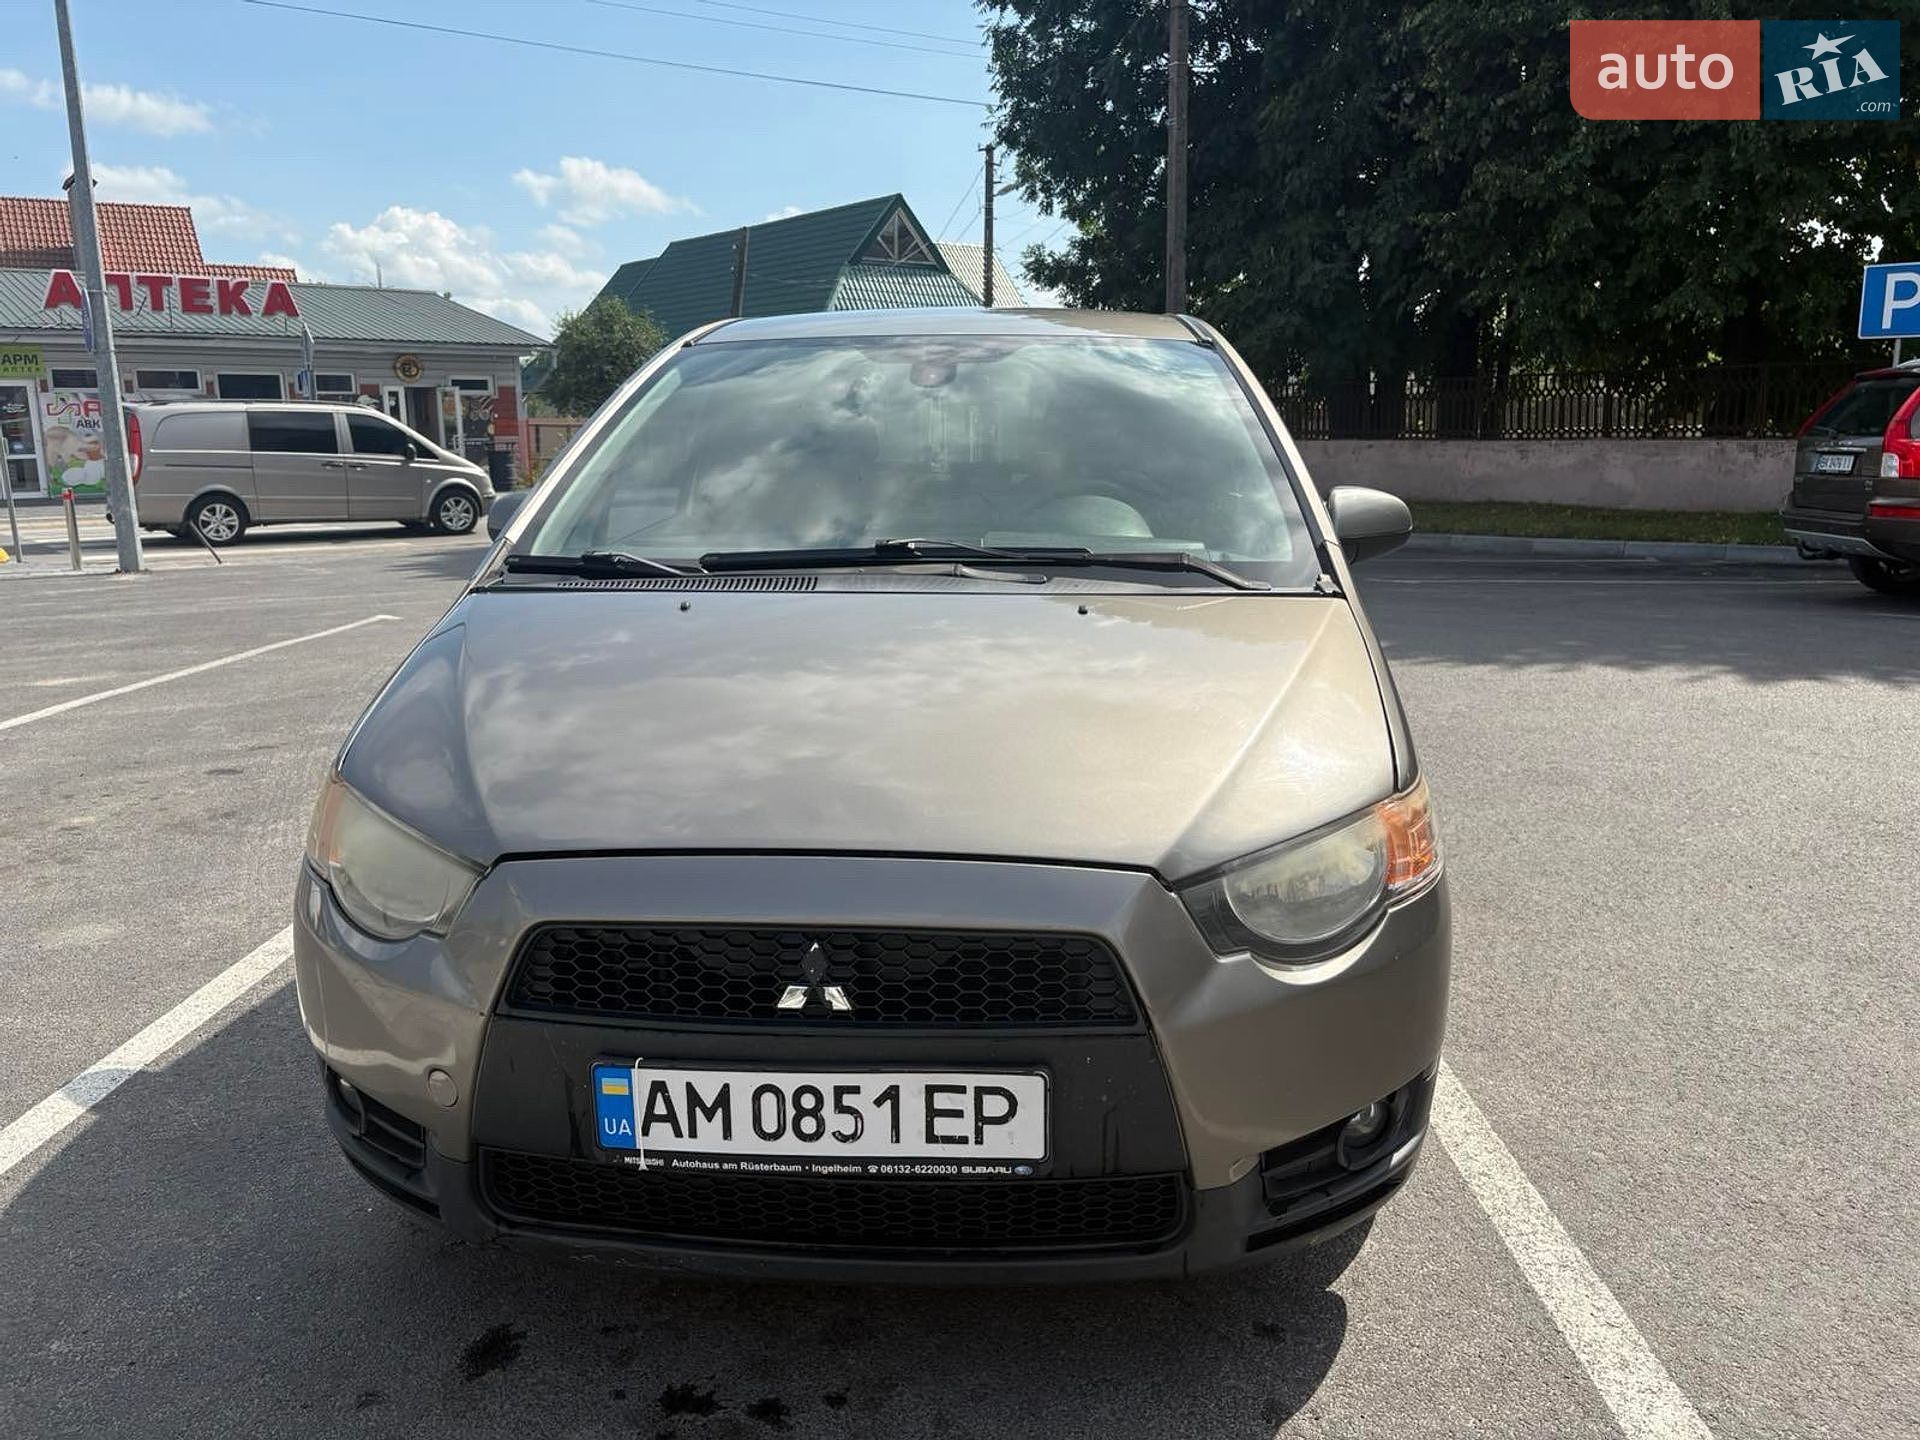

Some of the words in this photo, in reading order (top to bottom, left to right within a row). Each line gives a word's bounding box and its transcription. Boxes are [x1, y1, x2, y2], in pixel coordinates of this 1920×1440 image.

[1882, 272, 1920, 329] P
[604, 1118, 632, 1136] UA
[641, 1080, 732, 1141] AM
[751, 1083, 900, 1144] 0851
[925, 1084, 1018, 1145] EP
[672, 1159, 720, 1170] Autohaus
[722, 1162, 738, 1170] am
[740, 1161, 802, 1172] Rüsterbaum
[812, 1164, 862, 1174] Ingelheim
[880, 1164, 958, 1174] 06132-6220030
[961, 1166, 1012, 1174] SUBARU
